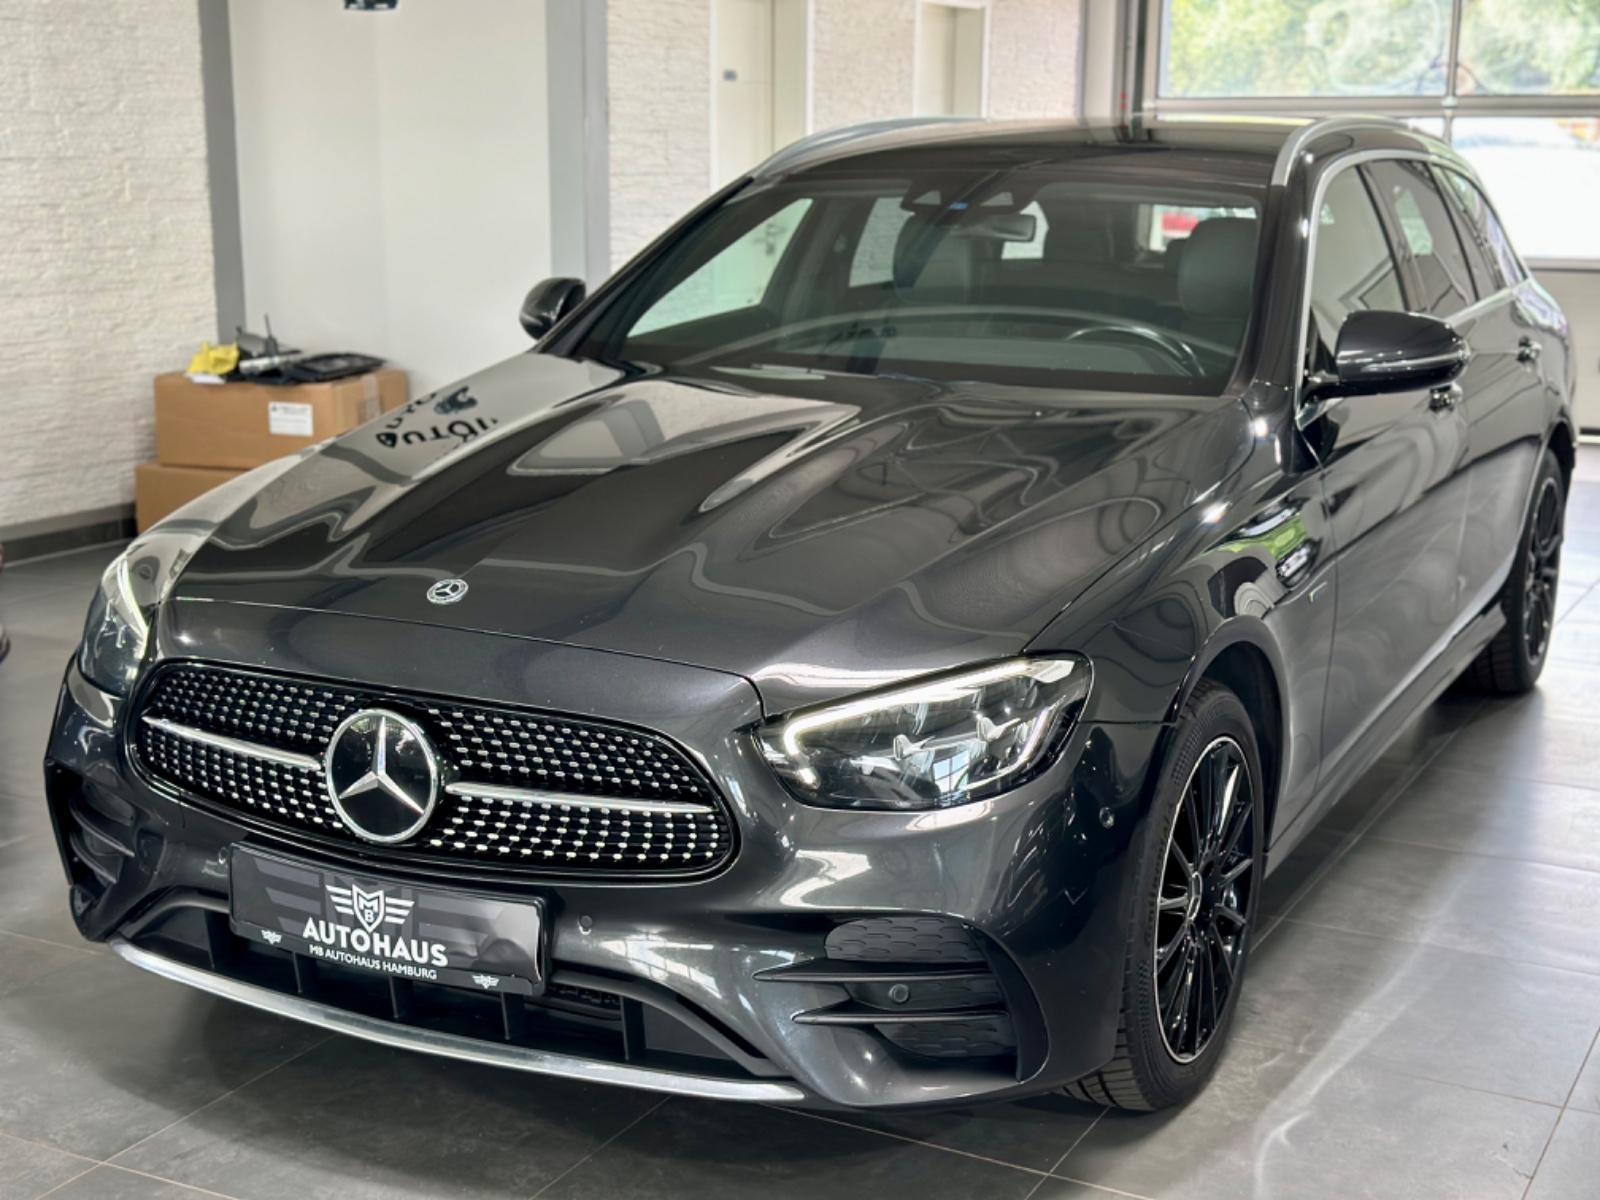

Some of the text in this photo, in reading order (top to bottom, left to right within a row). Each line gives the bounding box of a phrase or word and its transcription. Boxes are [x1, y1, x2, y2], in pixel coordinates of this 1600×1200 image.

[302, 916, 448, 967] AUTOHAUS
[325, 949, 381, 970] AUTOHAUS
[382, 961, 438, 980] HAMBURG
